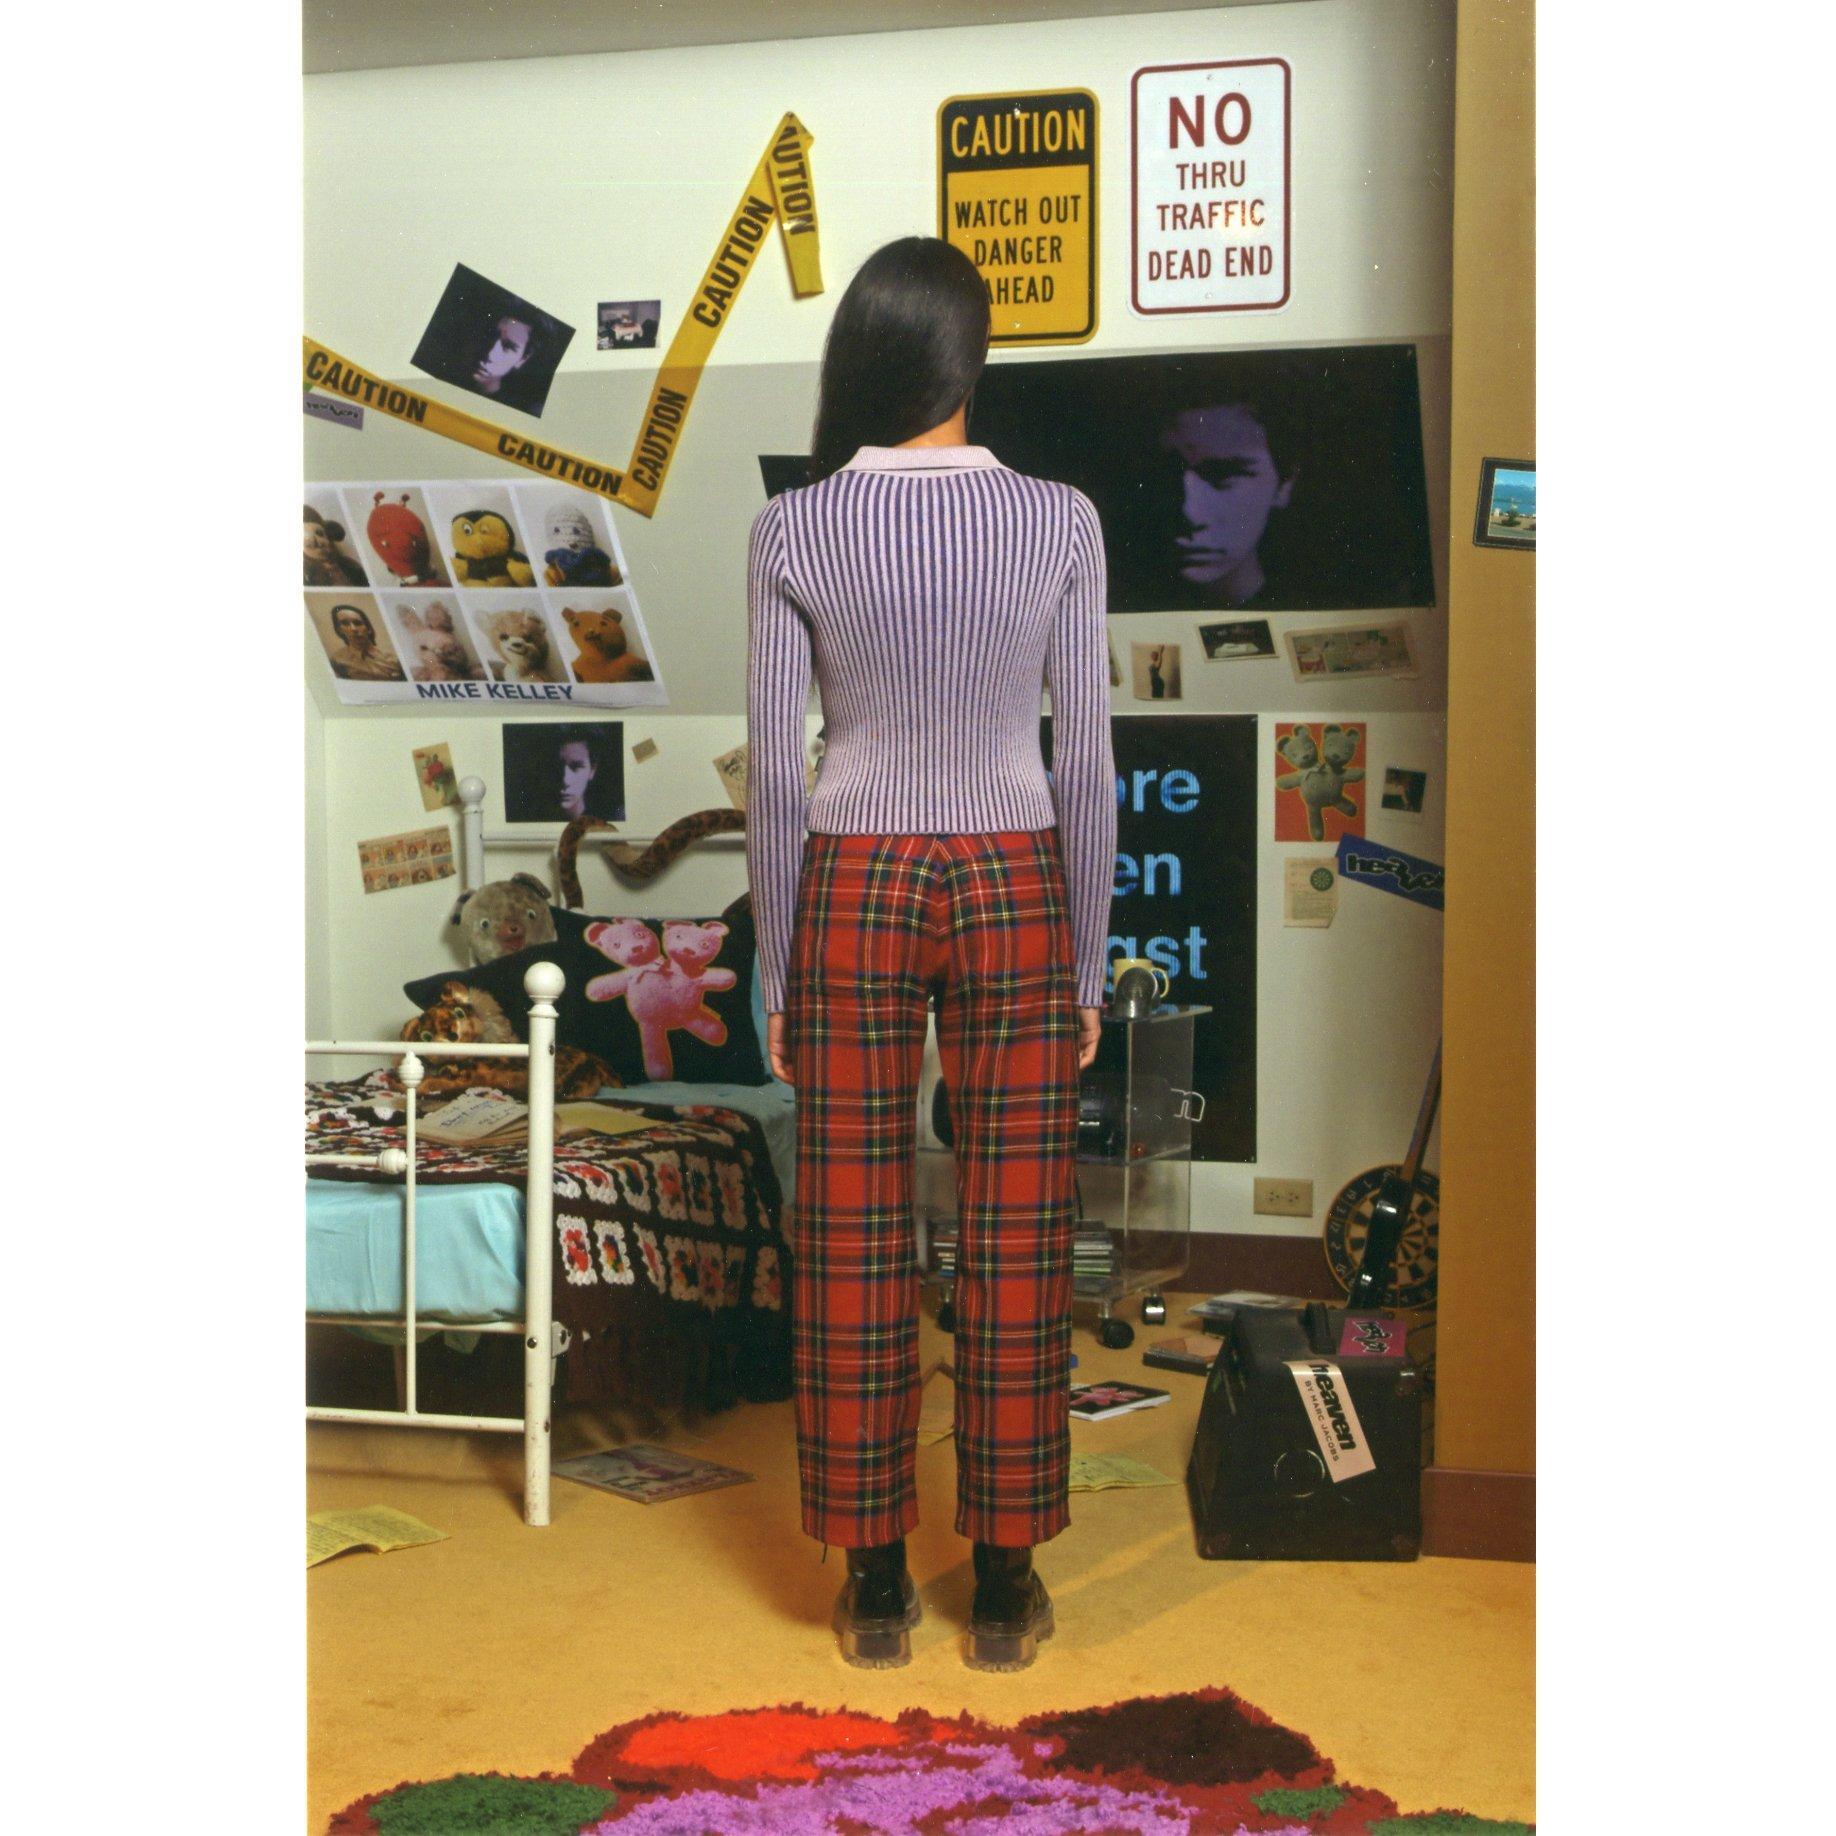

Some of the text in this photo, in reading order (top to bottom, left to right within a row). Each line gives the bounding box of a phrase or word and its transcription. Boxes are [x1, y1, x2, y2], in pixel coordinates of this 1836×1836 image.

[950, 109, 1086, 158] CAUTION
[1168, 92, 1252, 150] NO
[1176, 159, 1246, 191] THRU
[955, 195, 1081, 229] WATCH OUT
[1157, 199, 1265, 232] TRAFFIC
[693, 195, 775, 329] CAUTION
[974, 236, 1062, 267] DANGER
[1148, 245, 1273, 281] DEAD END
[306, 350, 428, 423] CAUTION
[631, 387, 688, 492] CAUTION
[497, 432, 624, 497] CAUTION
[416, 683, 573, 700] MIKE KELLEY
[1346, 853, 1444, 892] heave
[1304, 1380, 1340, 1463] BY MARC JACOBS
[1309, 1364, 1357, 1451] heaven
